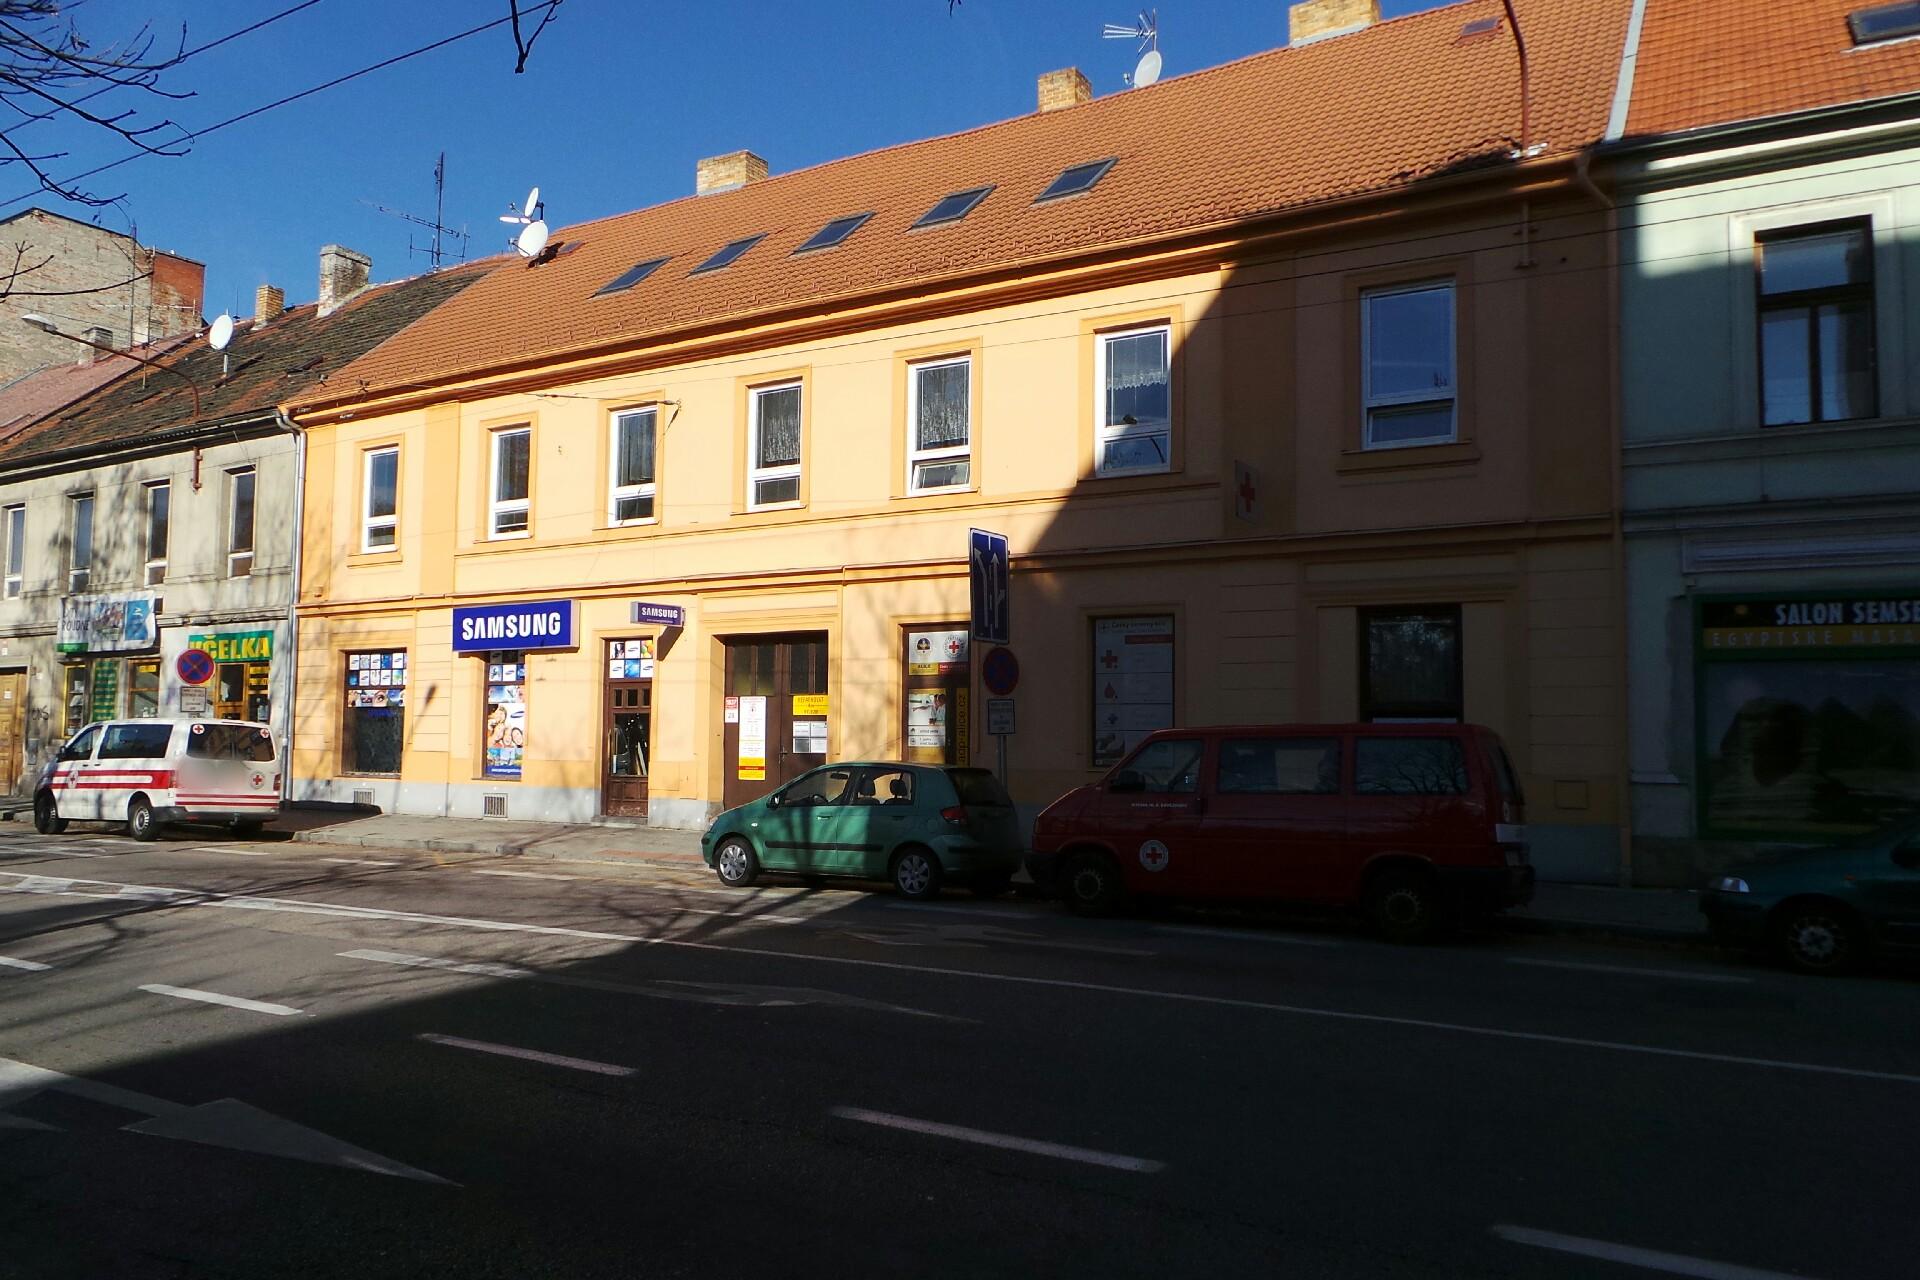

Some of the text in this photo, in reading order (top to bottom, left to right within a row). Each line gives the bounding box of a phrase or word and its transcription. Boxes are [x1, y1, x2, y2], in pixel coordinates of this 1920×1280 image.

[641, 607, 679, 619] SAMSUNG
[1776, 602, 1844, 625] SALON
[462, 611, 561, 641] SAMSUNG
